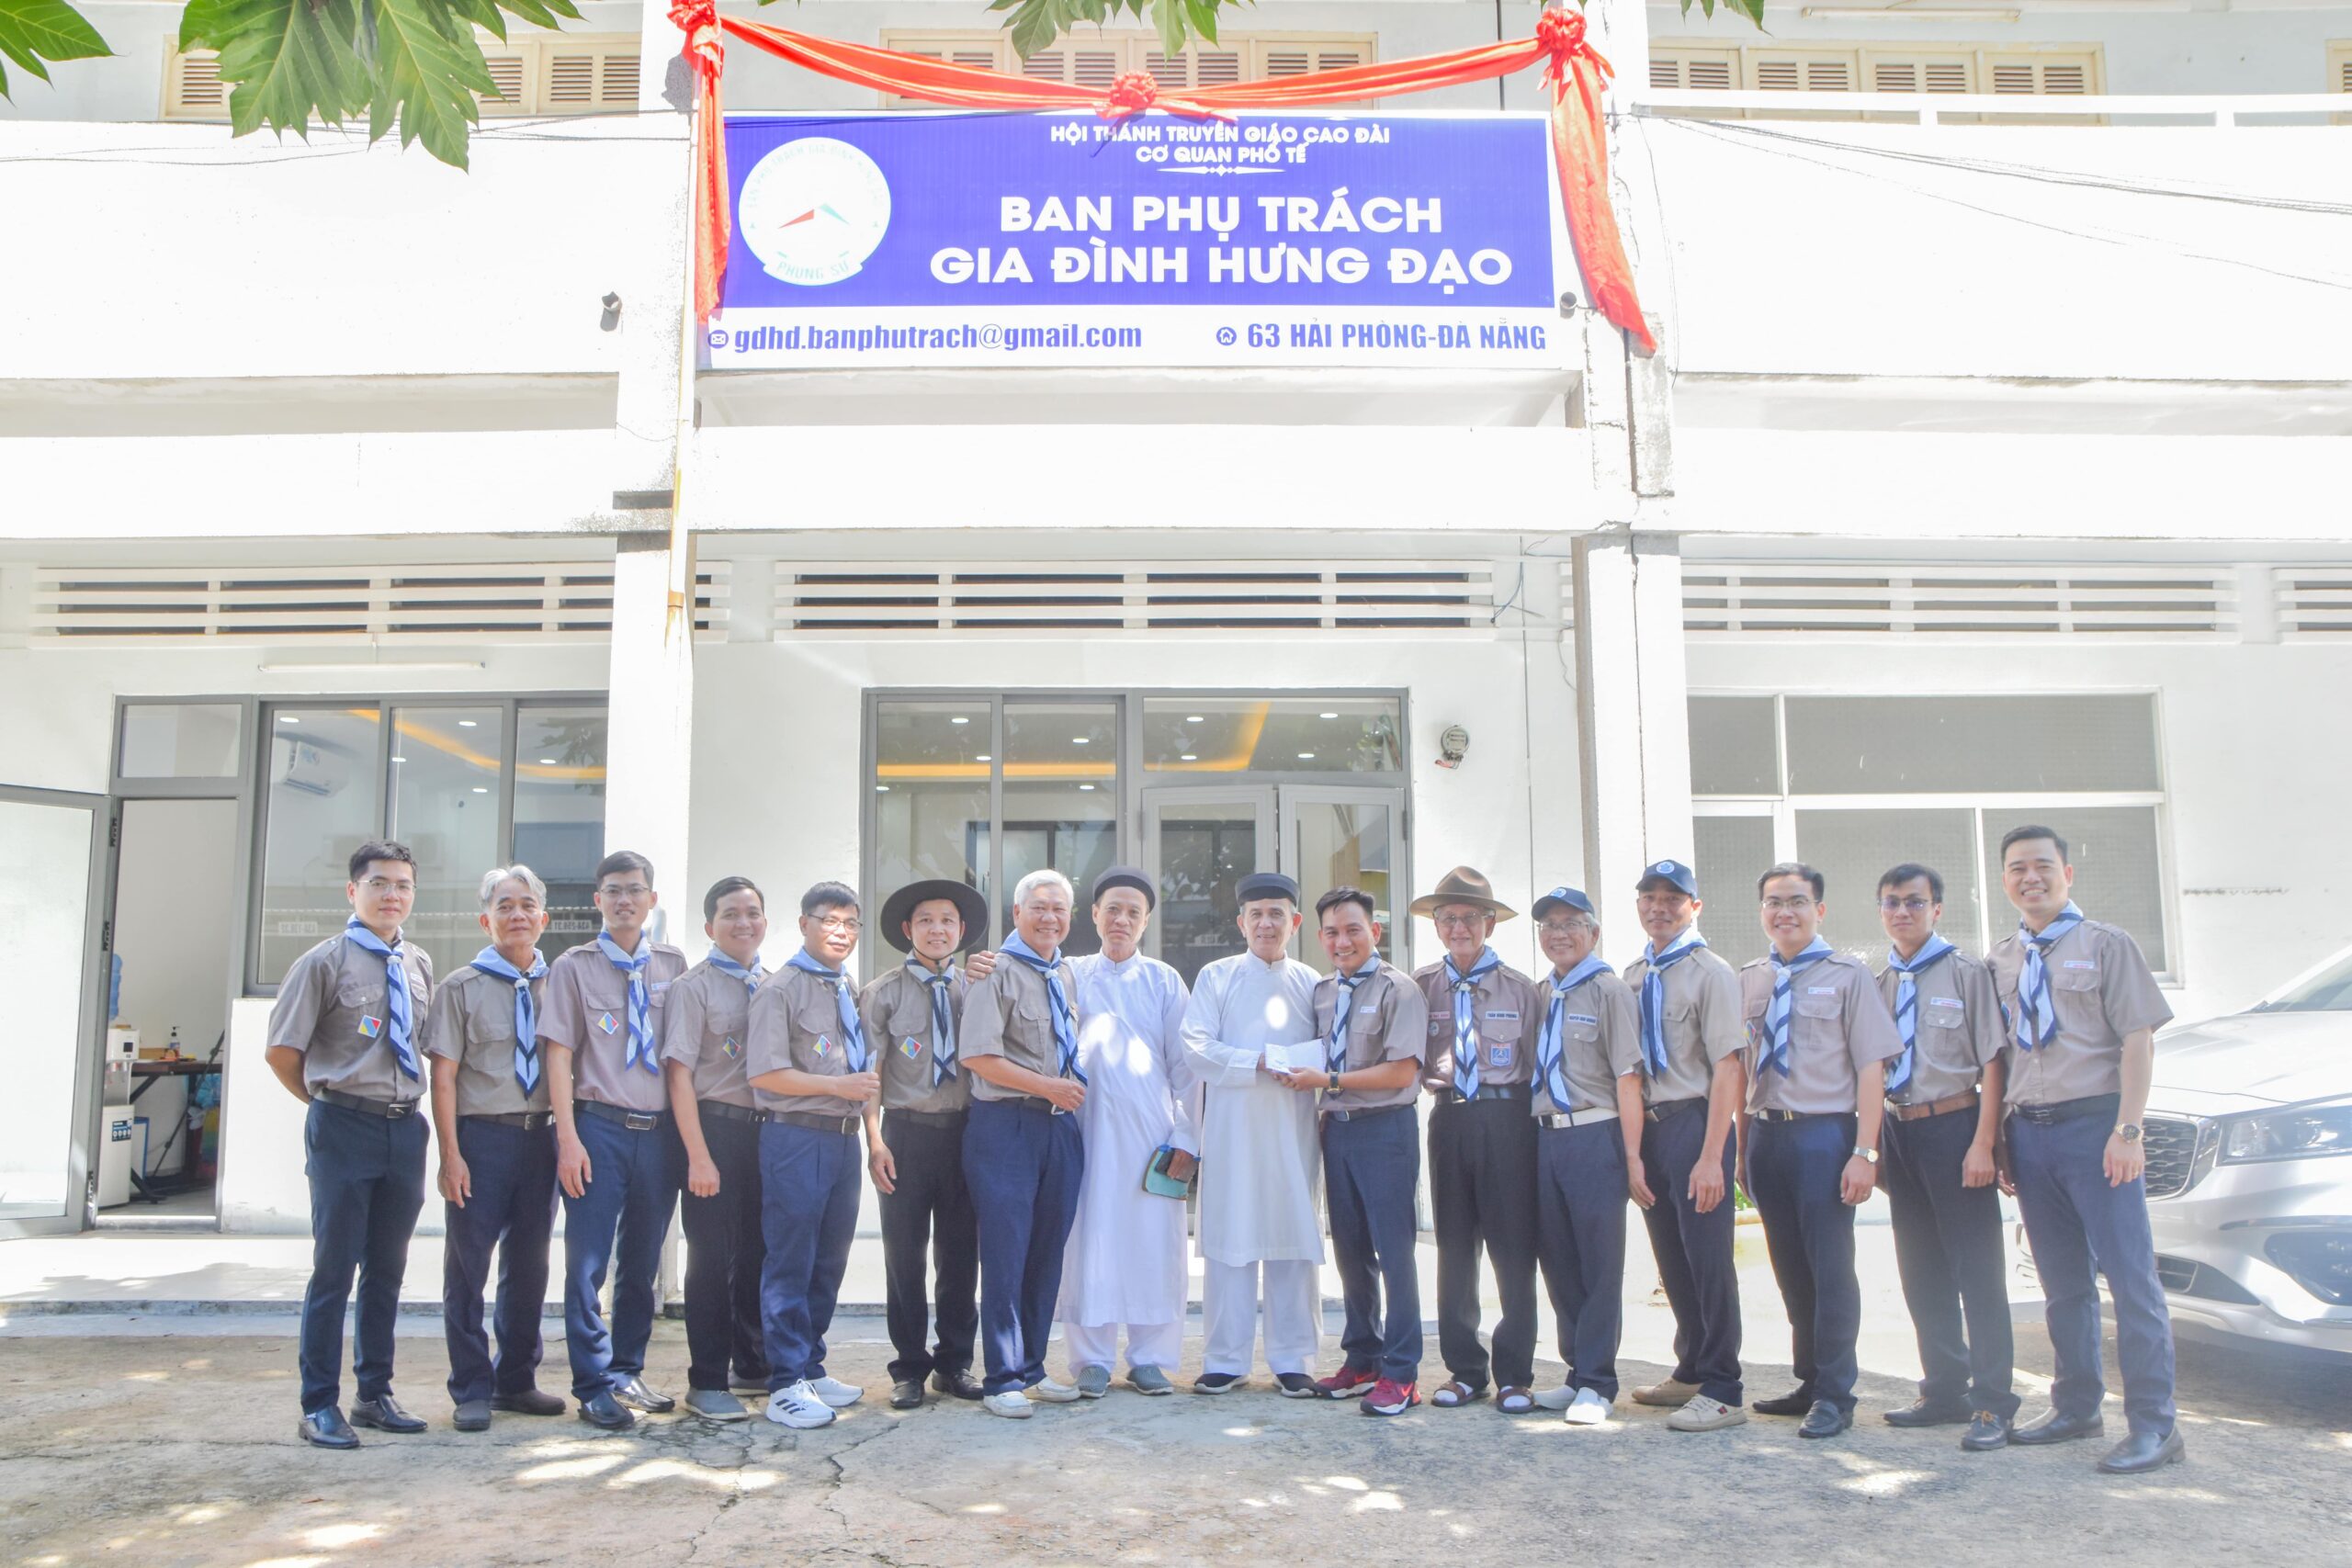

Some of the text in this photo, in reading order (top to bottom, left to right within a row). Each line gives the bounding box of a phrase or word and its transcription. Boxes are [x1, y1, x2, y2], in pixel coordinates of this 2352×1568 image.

[1051, 120, 1390, 146] HỘI THÁNH TRUYỀN GIÁO CAO ĐÀI
[1136, 144, 1169, 163] CƠ
[1173, 146, 1232, 163] QUAN
[1285, 142, 1309, 164] TẾ
[1001, 186, 1442, 242] BAN PHỤ TRÁCH
[930, 236, 1513, 294] GIA ĐÌNH HƯNG ĐẠO
[734, 323, 1142, 353] gdhd.banphutrach@gmail.com
[1248, 323, 1281, 348] 63
